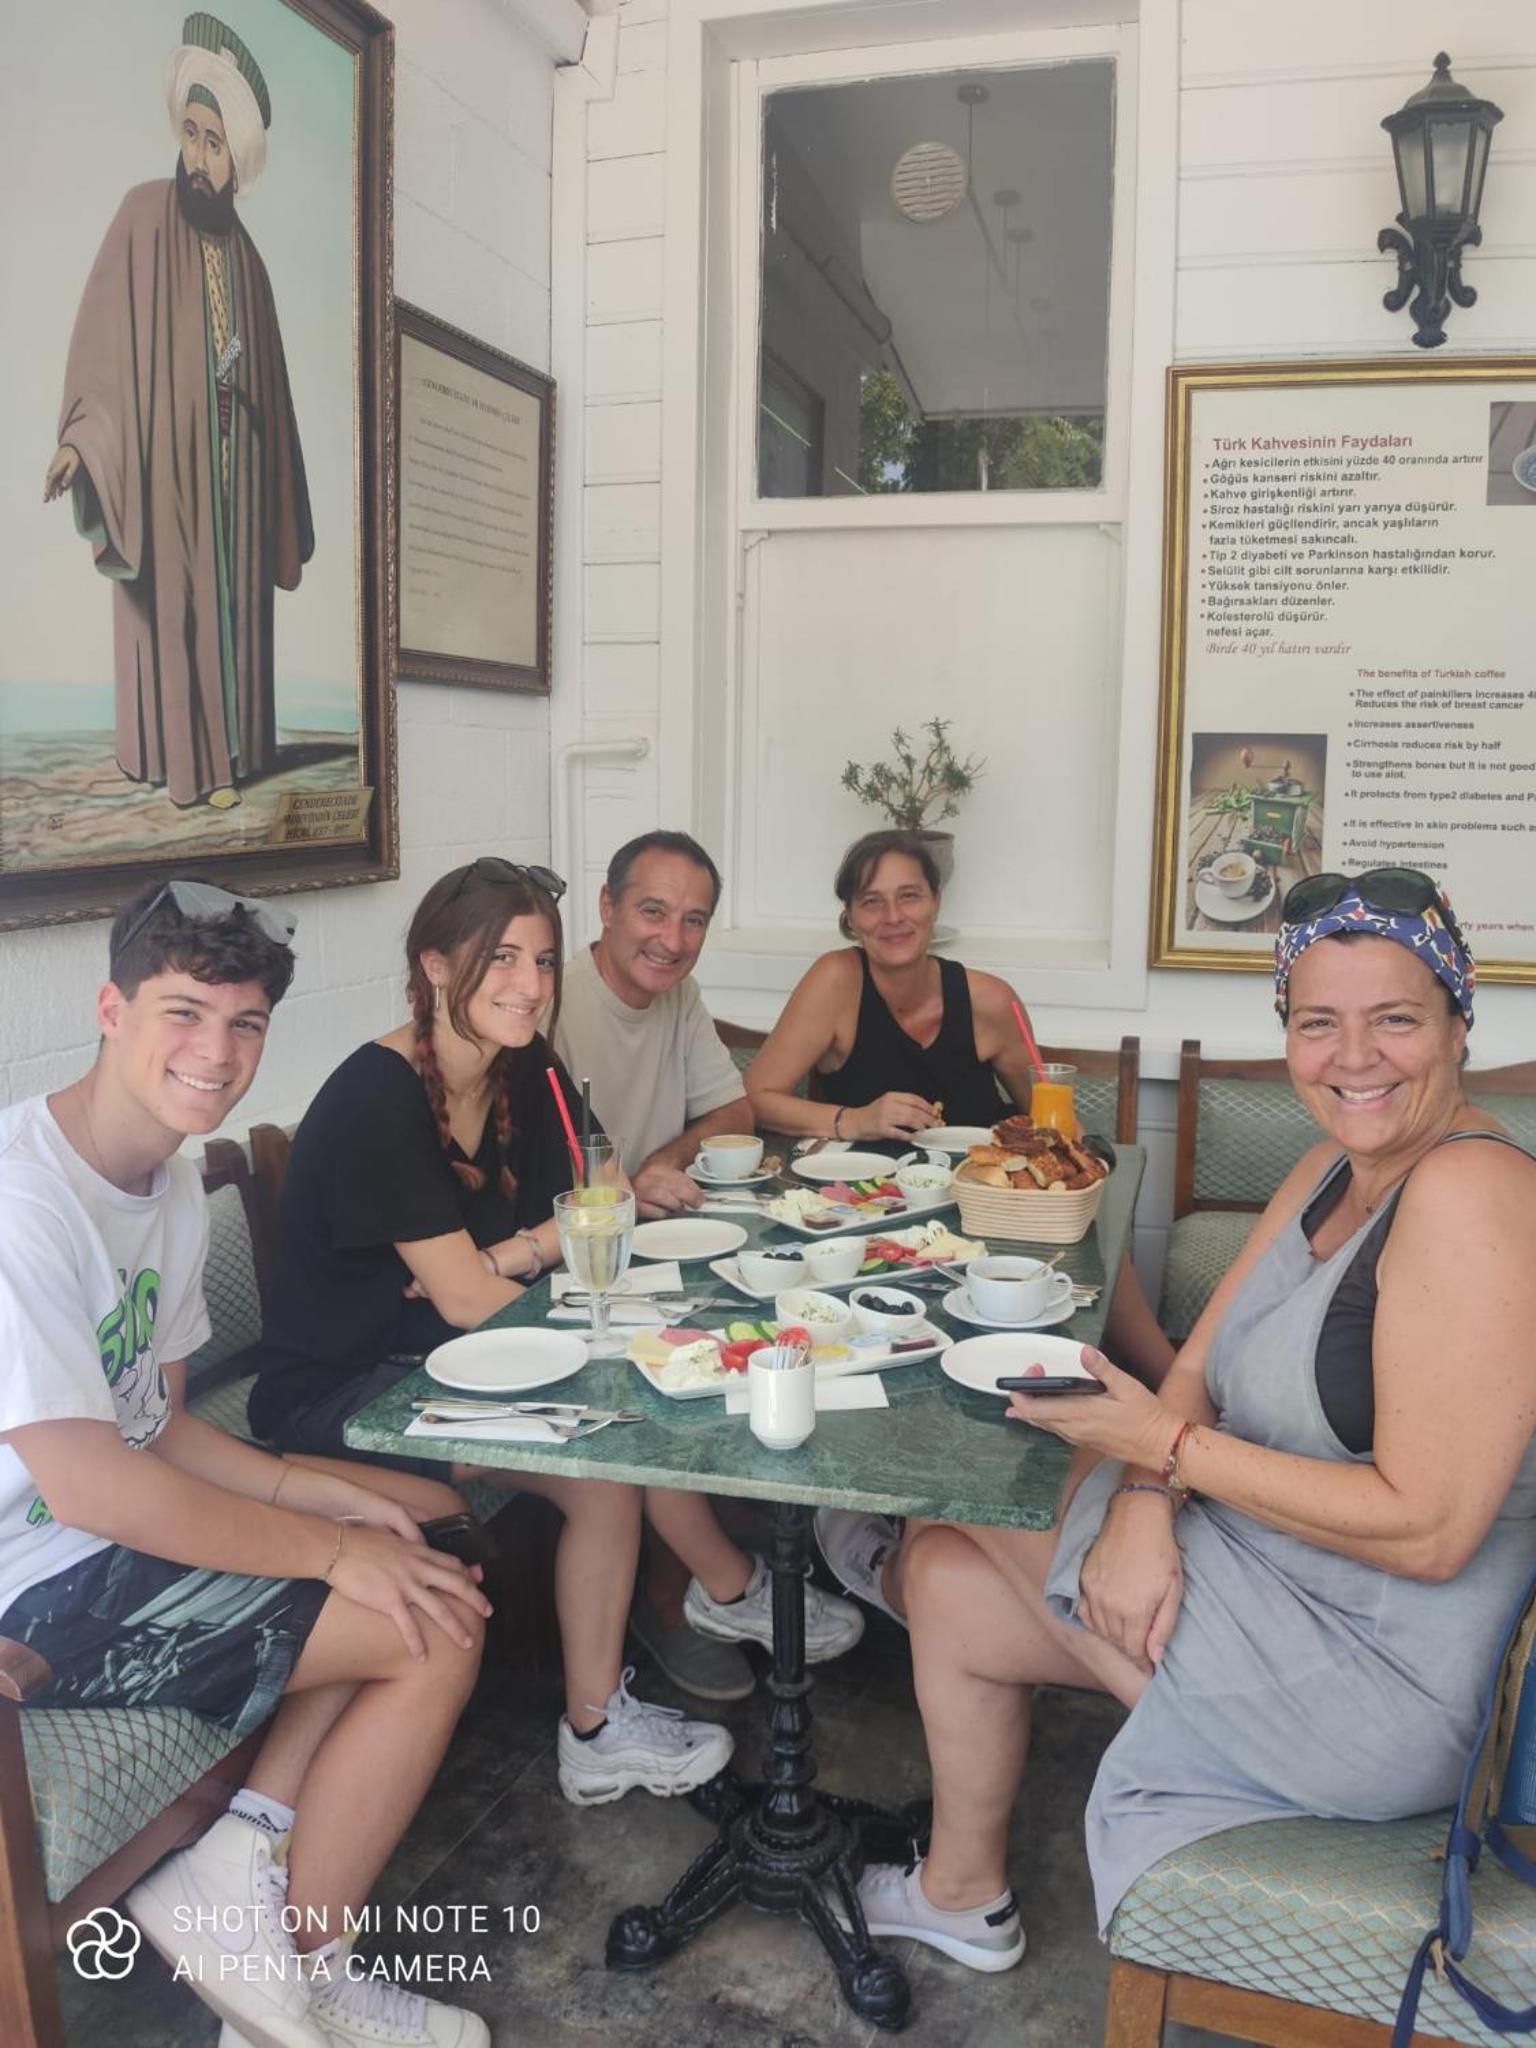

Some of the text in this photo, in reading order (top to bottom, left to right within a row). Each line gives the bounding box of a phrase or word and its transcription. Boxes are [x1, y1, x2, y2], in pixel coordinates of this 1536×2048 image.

[1213, 435, 1413, 451] Türk Kahvesinin Faydaları
[1240, 457, 1300, 467] kesicilerin
[1347, 456, 1379, 467] yüzde
[1382, 455, 1396, 465] 40
[1399, 454, 1448, 465] oranında
[1210, 473, 1248, 486] Göğüs
[1253, 472, 1296, 483] kanseri
[1300, 471, 1337, 482] riskini
[1210, 489, 1247, 499] Kahve
[1210, 504, 1239, 514] Siroz
[1297, 502, 1335, 513] riskini
[1338, 503, 1360, 515] yarı
[1209, 519, 1264, 529] Kemikleri
[1343, 518, 1378, 528] ancak
[1209, 535, 1236, 545] fazla
[1240, 535, 1297, 545] tüketmesi
[1210, 550, 1226, 561] Tip
[1230, 550, 1237, 560] 2
[1240, 550, 1287, 562] diyabeti
[1291, 552, 1304, 560] ve
[1308, 549, 1369, 559] Parkinson
[1459, 548, 1496, 558] korur.
[1208, 566, 1245, 576] Selülit
[1249, 566, 1270, 577] gibi
[1274, 565, 1292, 575] cilt
[1208, 580, 1349, 592] Yüksek tansiyonu önler.
[1281, 596, 1335, 606] düzenler.
[1207, 611, 1274, 621] Kolesterolü
[1206, 627, 1274, 638] nefesi açar.
[1241, 643, 1256, 654] 40
[1357, 669, 1506, 678] The benefits of Turkish coffee
[1356, 689, 1374, 698] The
[1377, 689, 1405, 698] effect
[1407, 689, 1418, 698] of
[1420, 689, 1472, 700] painkillers
[1475, 689, 1524, 699] increases
[1355, 700, 1398, 708] Reduces
[1401, 700, 1417, 708] the
[1420, 700, 1438, 709] risk
[1441, 700, 1452, 709] of
[1454, 700, 1486, 709] breast
[1354, 720, 1402, 729] Increases
[1401, 739, 1441, 749] reduces
[1445, 740, 1463, 749] risk
[1466, 740, 1479, 751] by
[1481, 740, 1501, 750] half
[1415, 760, 1446, 769] bones
[1449, 760, 1466, 770] but
[1478, 761, 1487, 770] is
[1489, 761, 1506, 770] not
[1509, 761, 1536, 772] good
[1352, 770, 1362, 778] to
[1360, 790, 1400, 800] protects
[1403, 790, 1427, 799] from
[1460, 791, 1502, 800] diabetes
[1505, 792, 1524, 800] and
[1359, 819, 1368, 827] is
[1370, 819, 1412, 829] effective
[1414, 820, 1424, 829] in
[1426, 820, 1448, 829] skin
[1451, 821, 1497, 832] problems
[1501, 822, 1526, 831] such
[1349, 839, 1377, 848] Avoid
[1507, 923, 1534, 931] when
